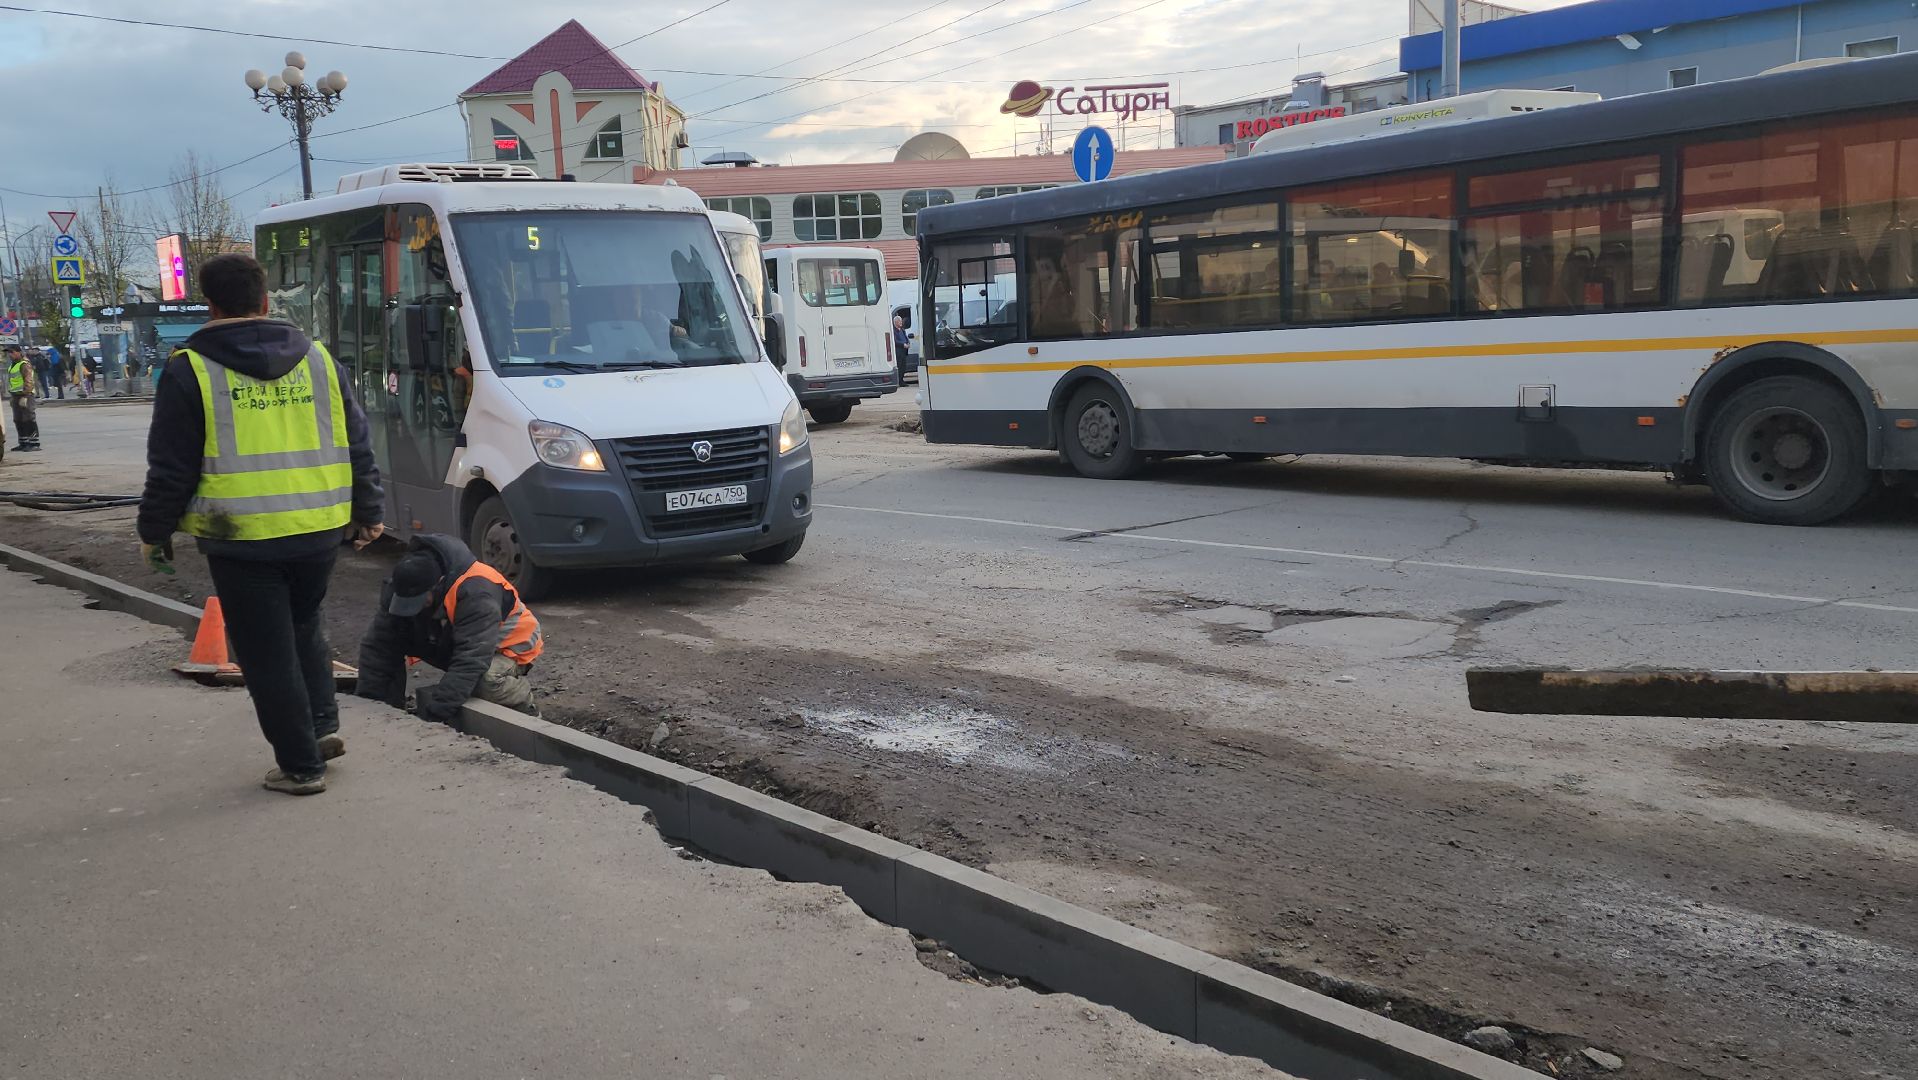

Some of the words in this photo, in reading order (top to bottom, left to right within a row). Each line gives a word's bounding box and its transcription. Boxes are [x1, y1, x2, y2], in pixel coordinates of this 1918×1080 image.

[1393, 107, 1455, 124] KONVEKTA
[527, 226, 541, 250] 5
[671, 491, 722, 508] Е074СА
[724, 487, 743, 498] 750
